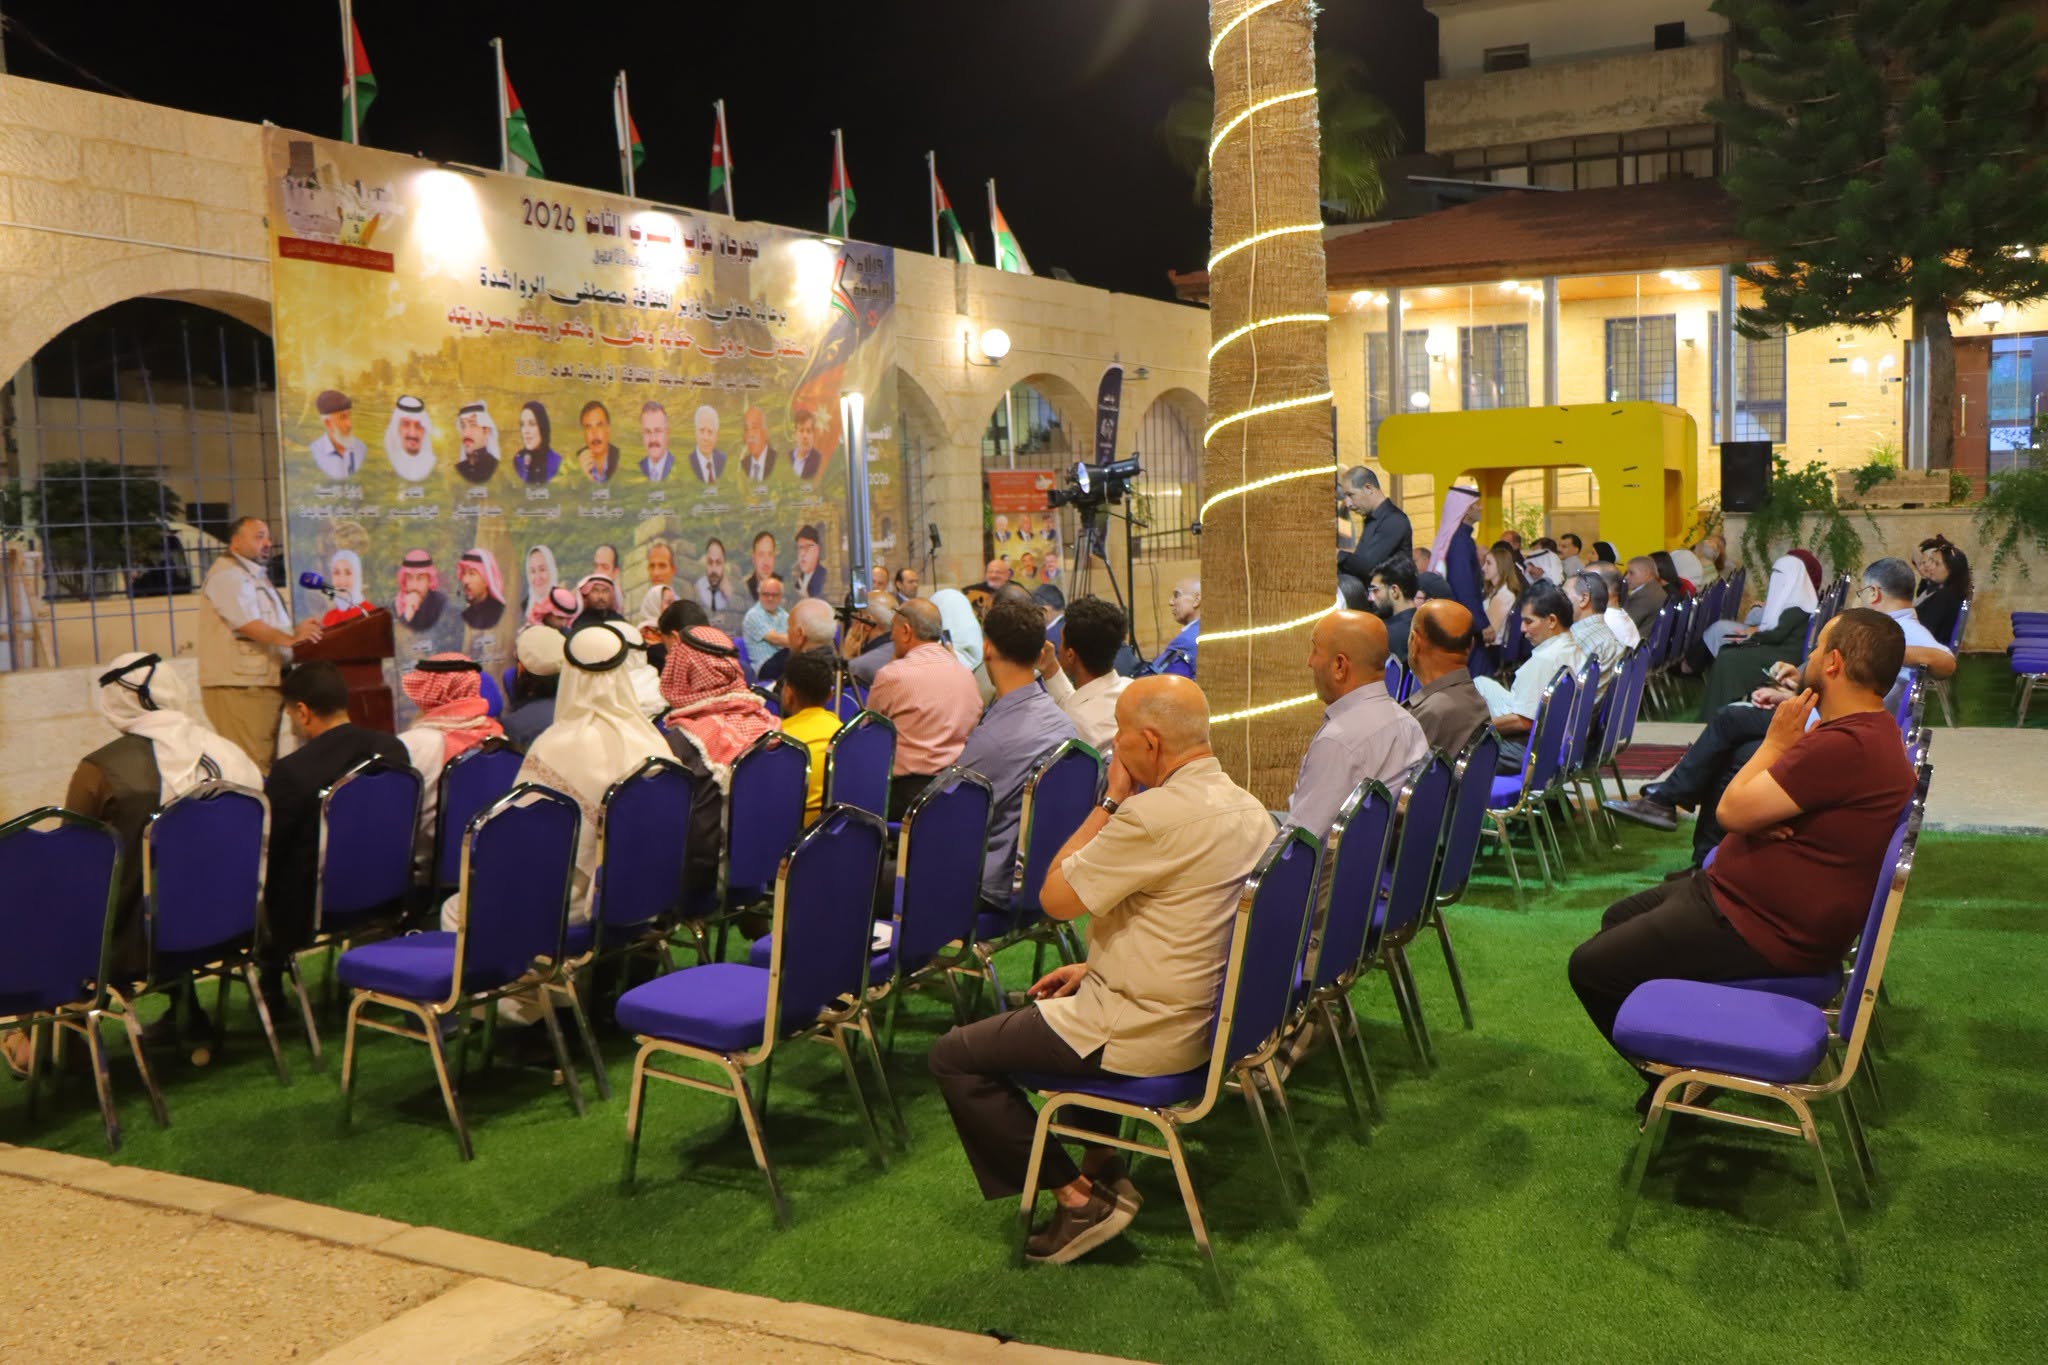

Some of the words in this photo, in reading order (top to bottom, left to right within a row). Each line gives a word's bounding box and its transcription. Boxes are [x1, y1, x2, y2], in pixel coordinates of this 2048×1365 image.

[522, 197, 576, 234] 2026
[585, 207, 622, 238] الثامن
[479, 265, 544, 301] الرواشدة
[547, 280, 626, 306] مصطفى
[677, 298, 702, 320] وزير
[704, 298, 751, 327] معالي
[598, 322, 654, 352] وطن
[658, 324, 694, 352] حكاية
